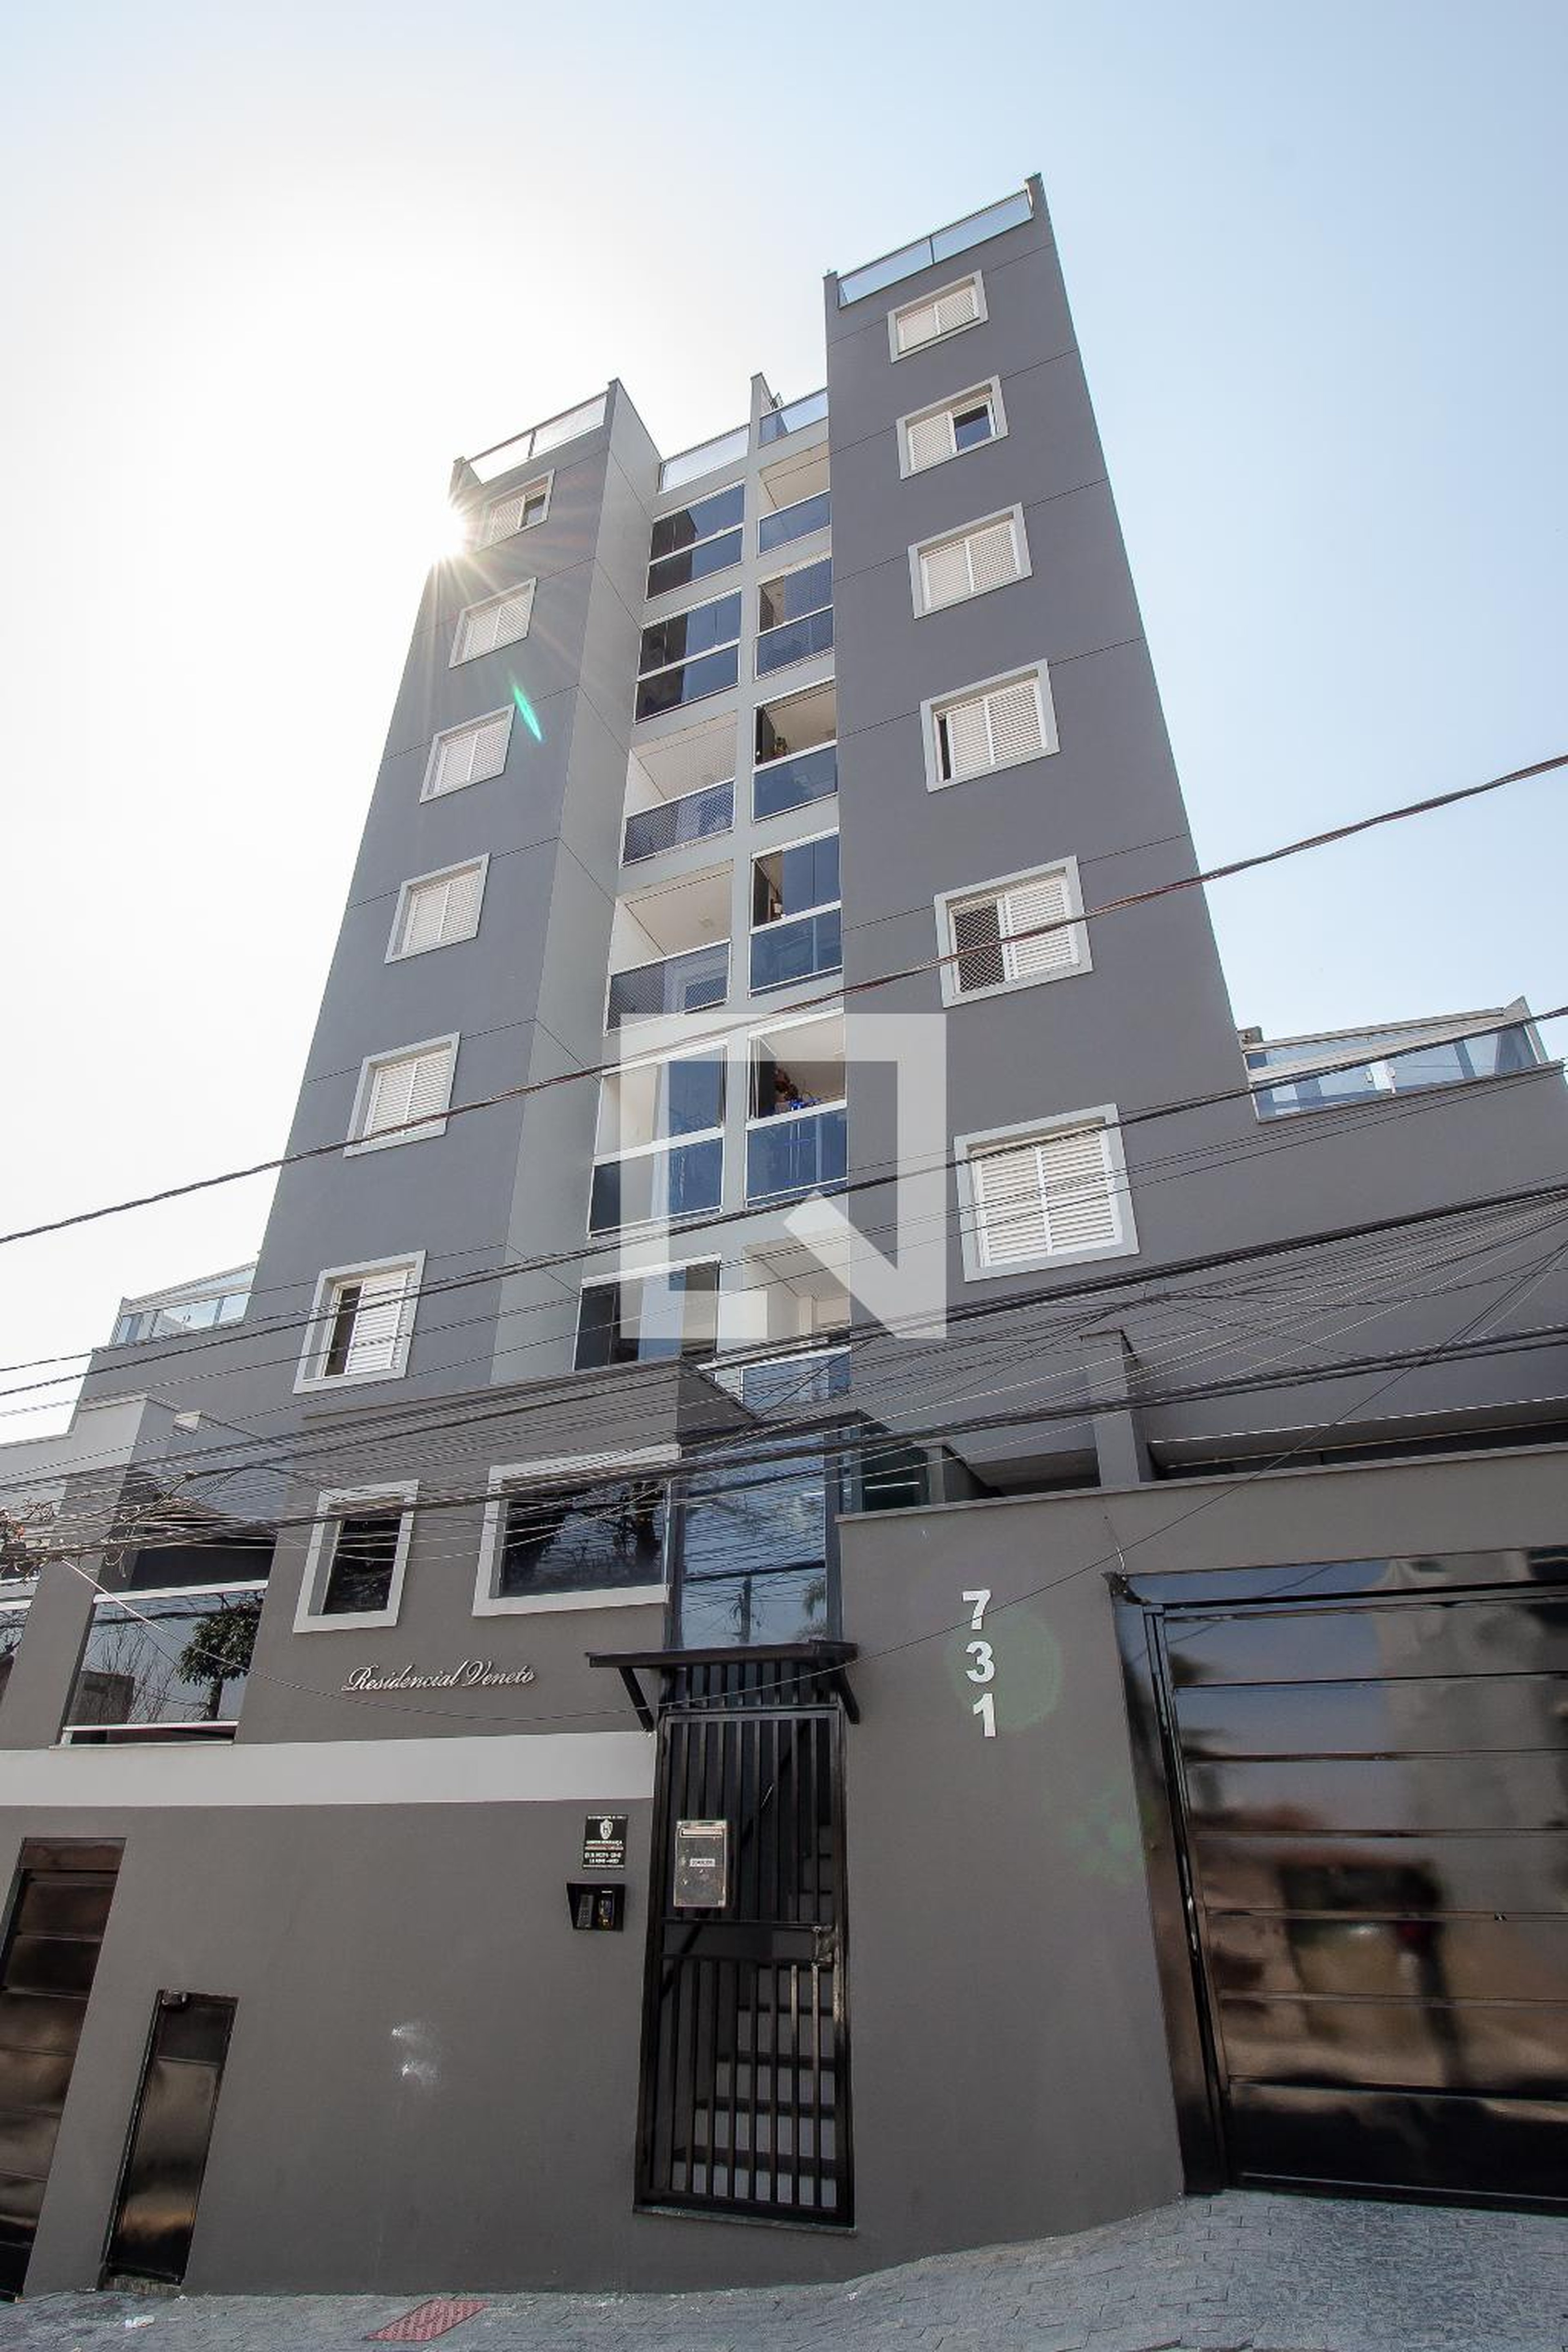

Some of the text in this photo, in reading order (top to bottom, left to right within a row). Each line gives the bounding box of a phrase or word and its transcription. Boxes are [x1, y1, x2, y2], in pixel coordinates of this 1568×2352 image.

[341, 1660, 535, 1691] Residencial Veneto
[962, 1590, 996, 1737] 731
